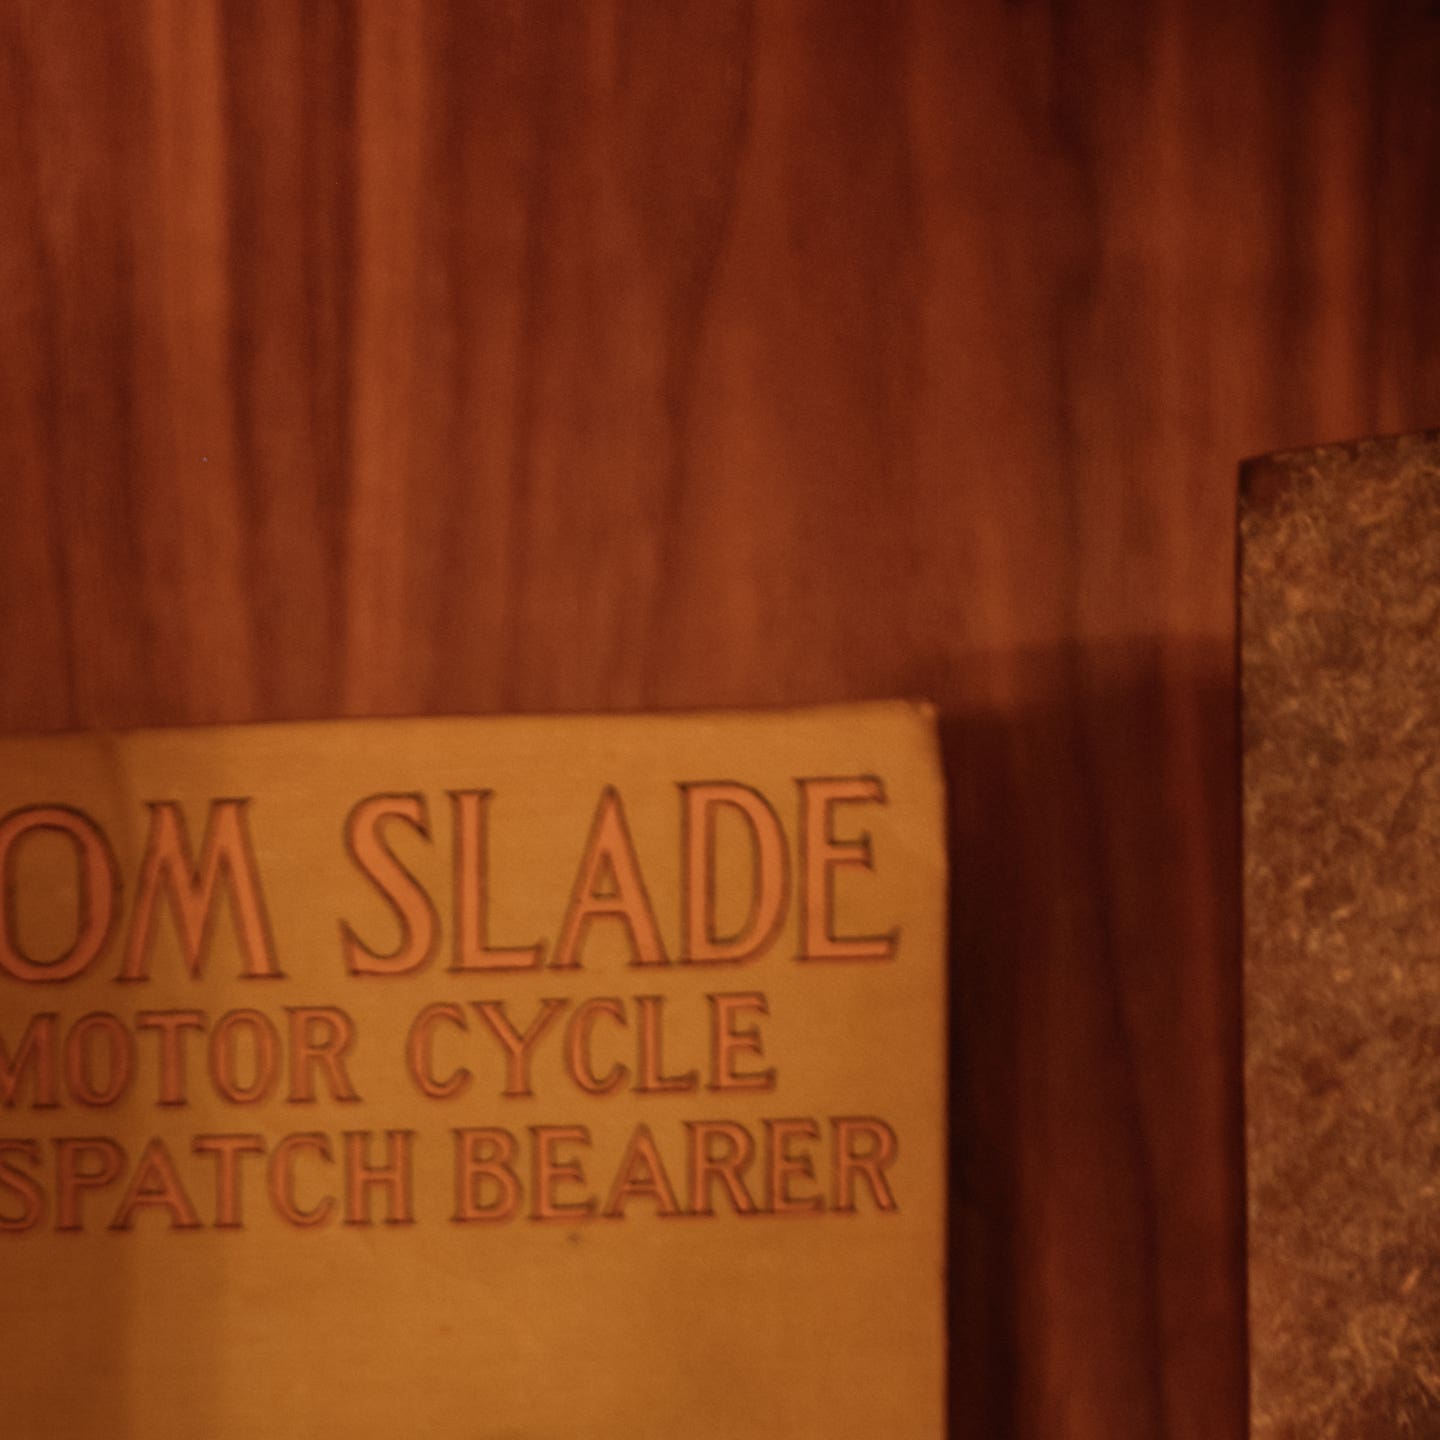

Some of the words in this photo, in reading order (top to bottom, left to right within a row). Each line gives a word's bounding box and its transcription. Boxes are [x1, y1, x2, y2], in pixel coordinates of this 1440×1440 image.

[338, 774, 902, 978] SLADE
[407, 992, 777, 1100] CYCLE
[450, 1115, 902, 1224] BEARER
